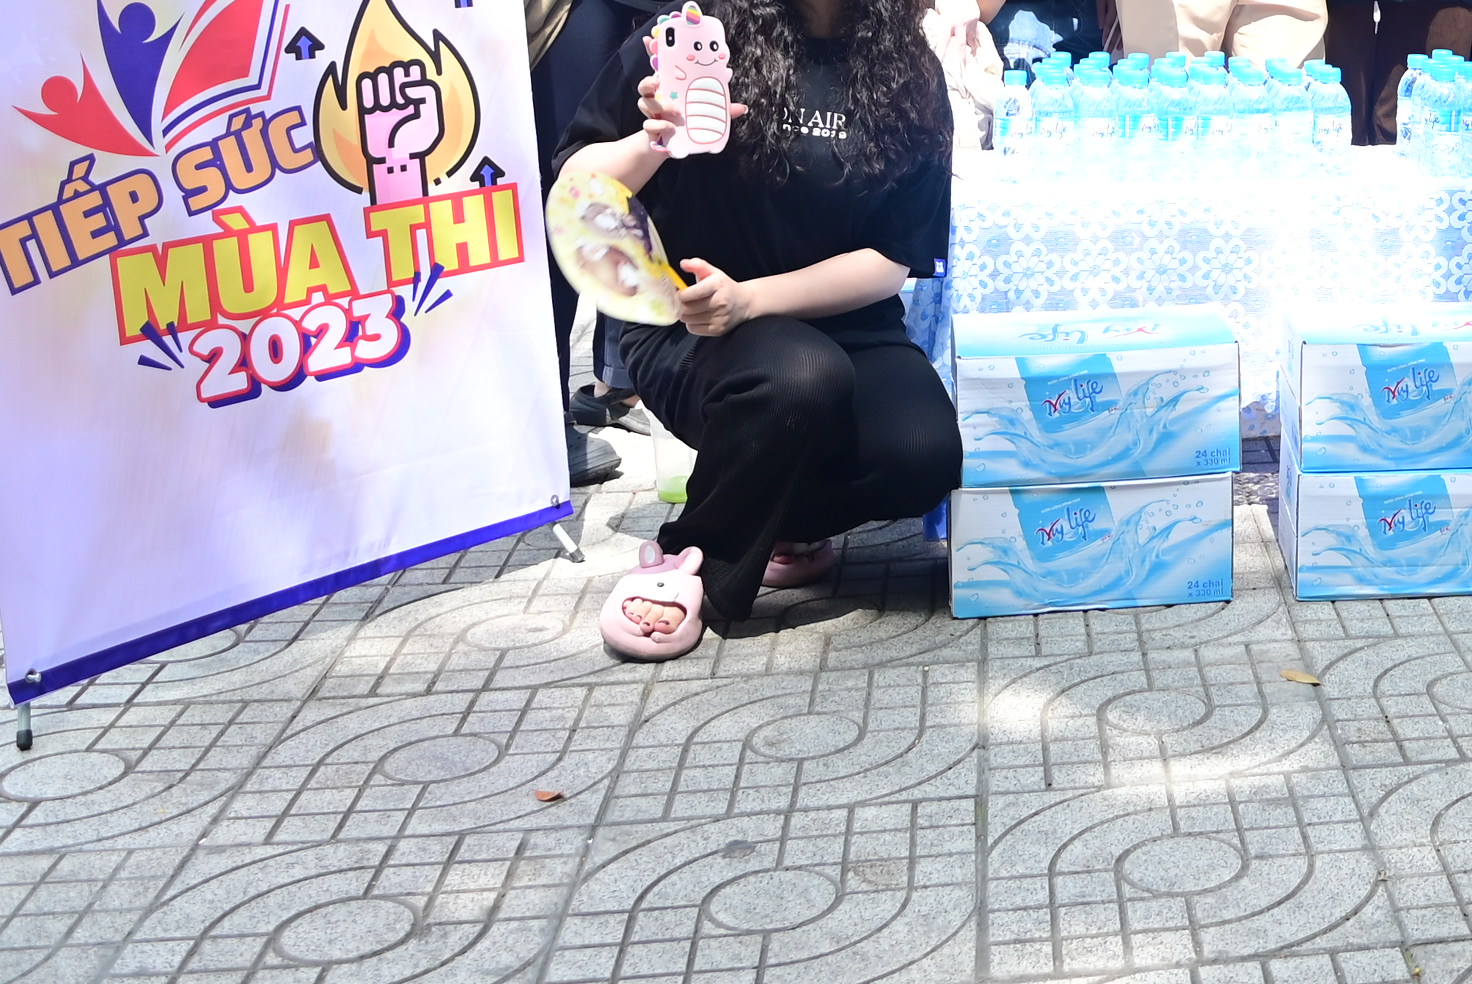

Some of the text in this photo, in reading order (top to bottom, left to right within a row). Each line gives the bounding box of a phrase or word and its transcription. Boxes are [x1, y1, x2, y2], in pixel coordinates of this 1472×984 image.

[807, 110, 847, 130] AIR
[812, 127, 847, 139] 2019
[0, 106, 318, 295] TIẾP SỨC
[109, 182, 525, 345] MÙA THI
[188, 289, 411, 408] 2023
[1042, 378, 1103, 416] My life
[1381, 366, 1440, 404] My life
[1195, 447, 1231, 459] 24 chai
[1202, 458, 1221, 466] 330
[1221, 457, 1231, 465] ml
[1036, 507, 1096, 546] My life
[1377, 508, 1406, 535] My
[1407, 497, 1437, 532] life
[1187, 578, 1224, 589] 24 chai
